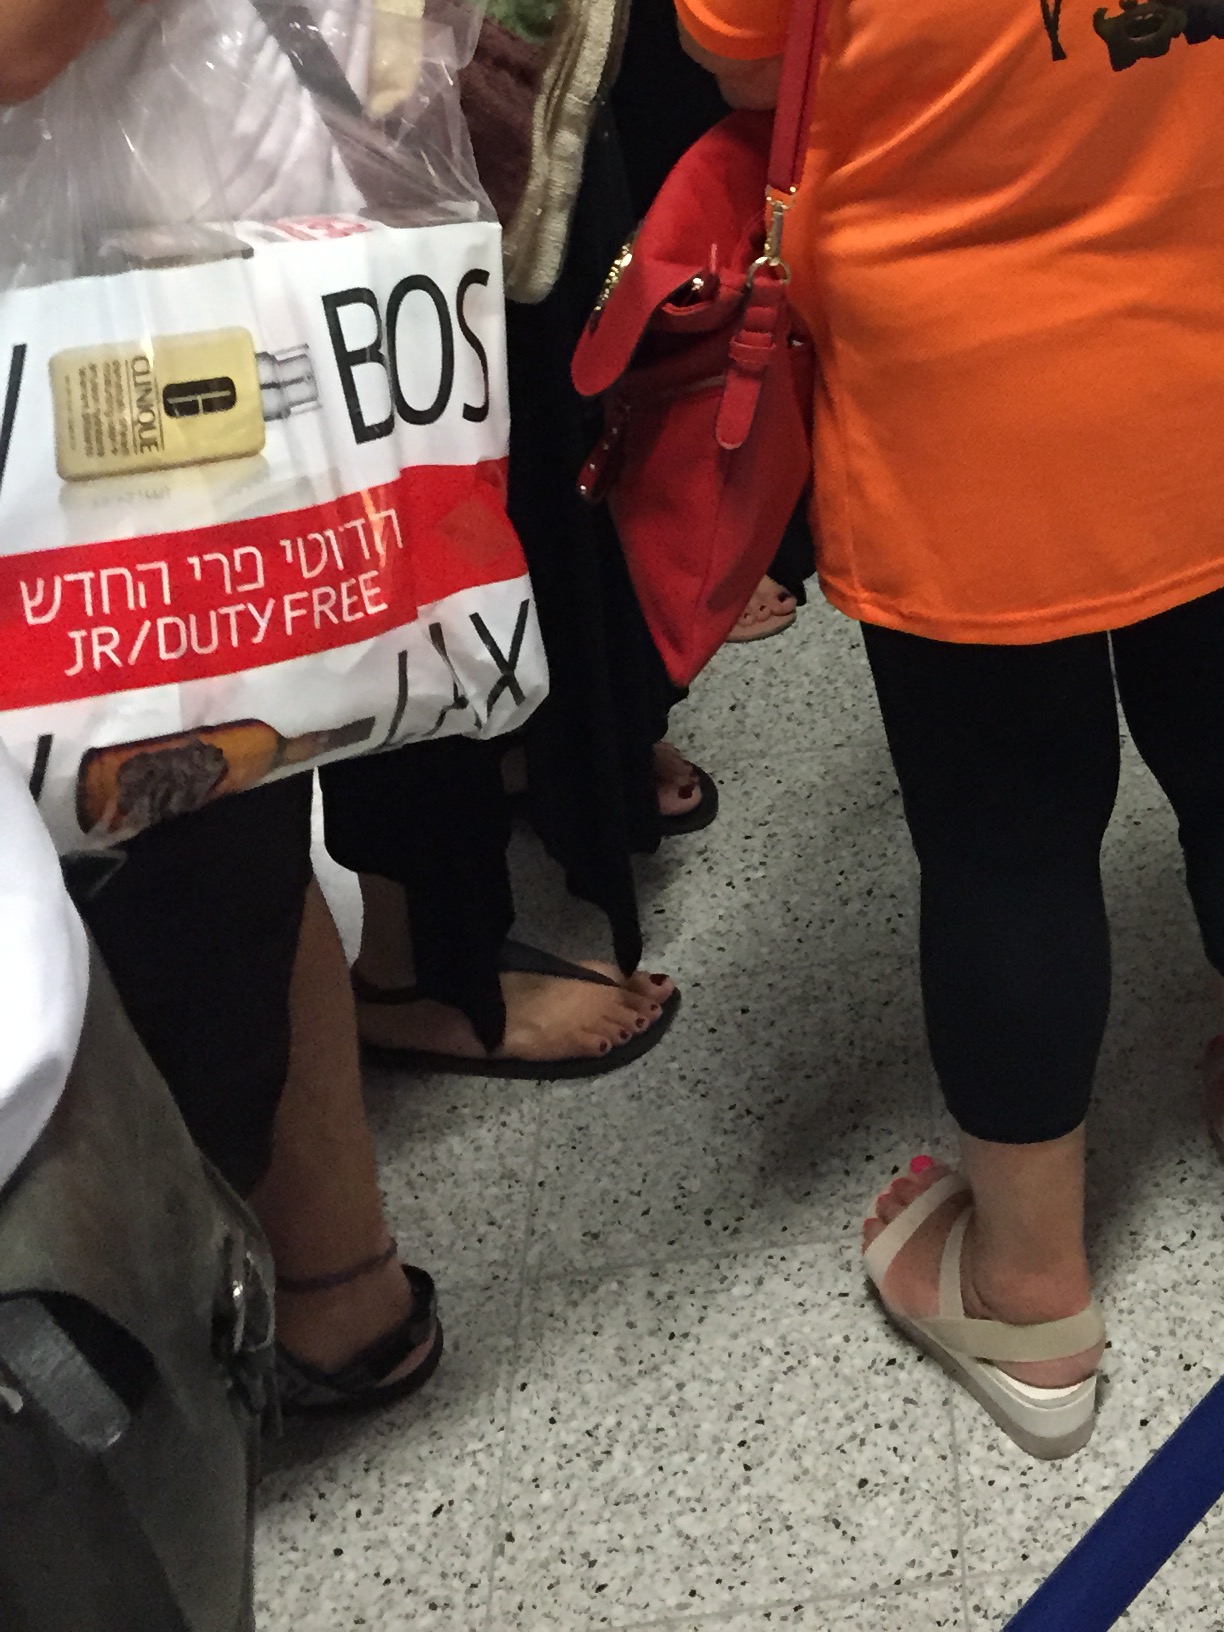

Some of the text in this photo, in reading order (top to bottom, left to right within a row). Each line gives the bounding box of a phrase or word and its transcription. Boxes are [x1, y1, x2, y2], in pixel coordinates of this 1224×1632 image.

[131, 355, 160, 454] CLINIQUE
[19, 560, 172, 626] החדש
[187, 545, 265, 595] פרי
